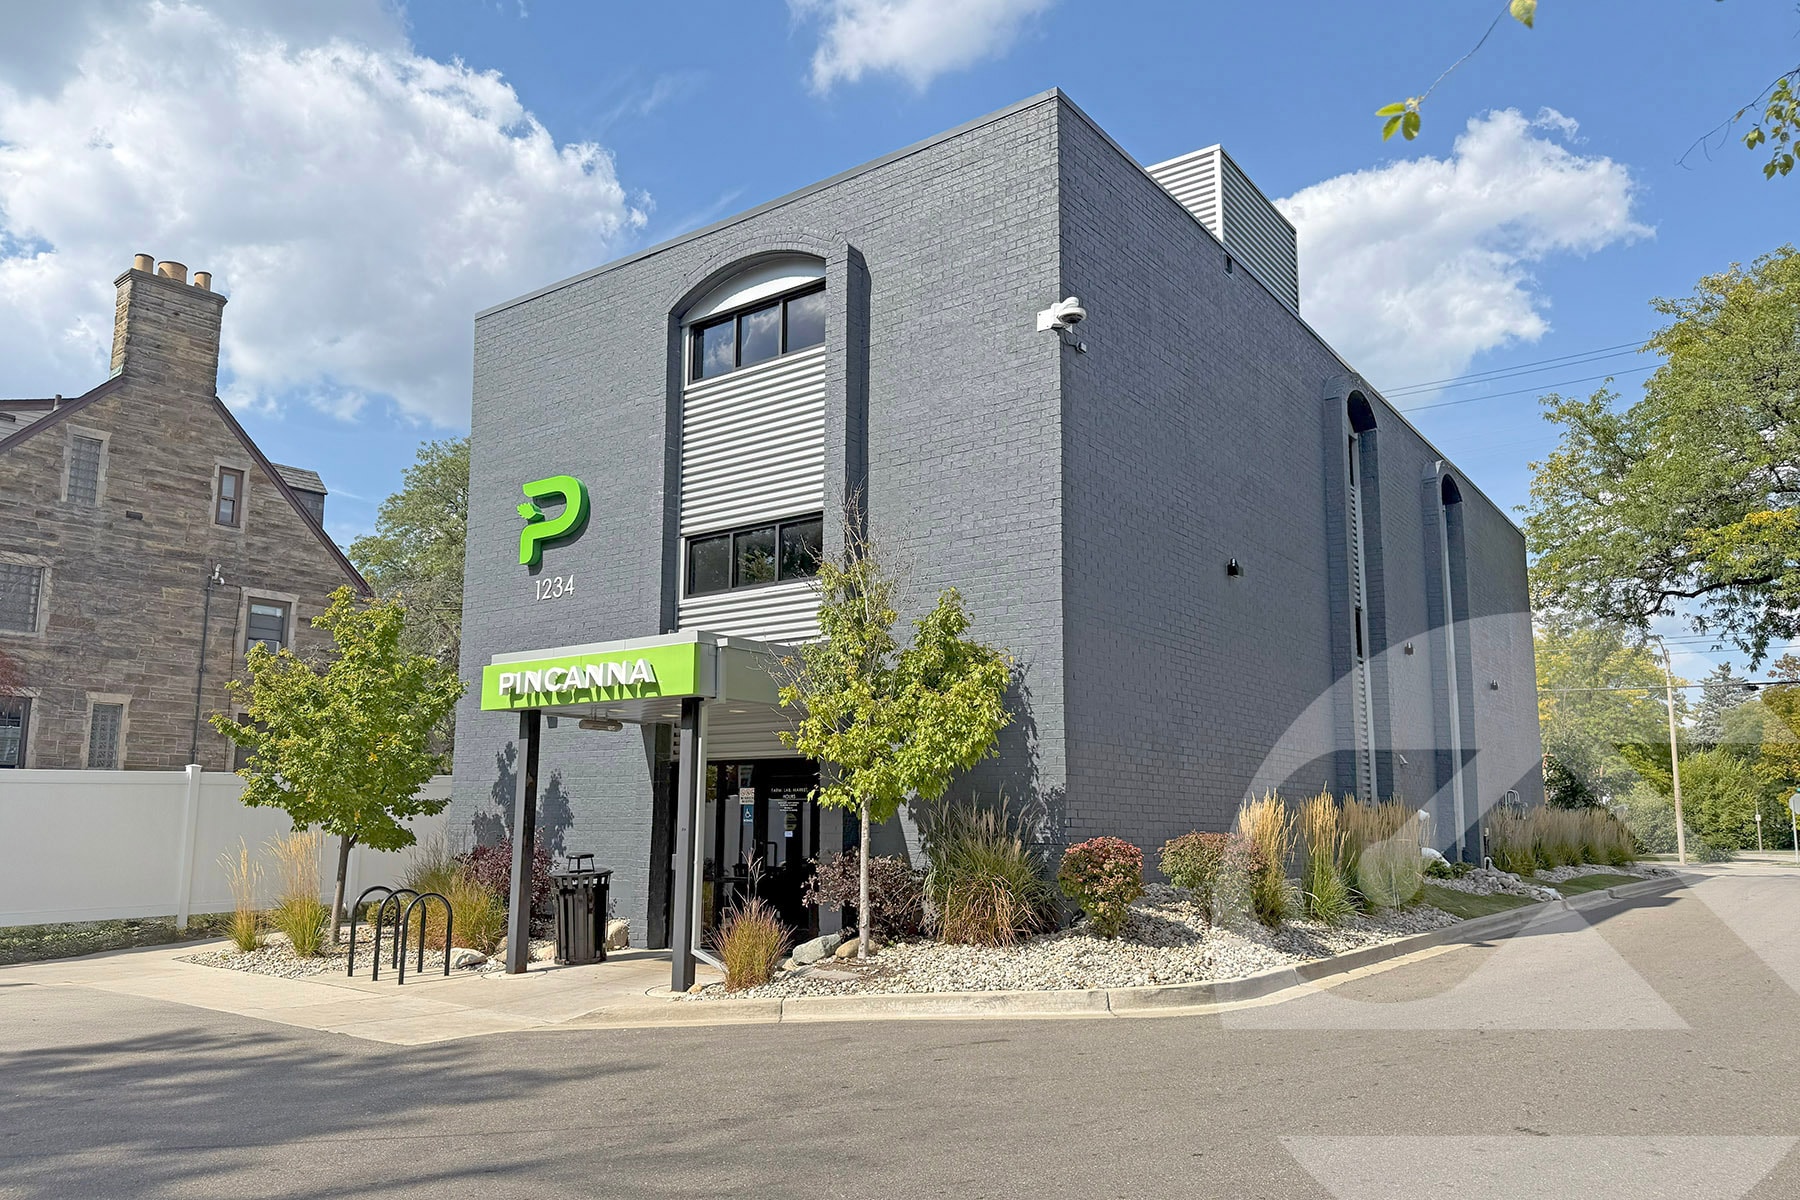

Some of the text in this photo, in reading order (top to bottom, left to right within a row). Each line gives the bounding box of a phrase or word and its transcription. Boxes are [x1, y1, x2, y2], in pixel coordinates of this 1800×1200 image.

[516, 475, 589, 565] P
[536, 576, 574, 601] 1234
[499, 659, 656, 696] PINCANNA
